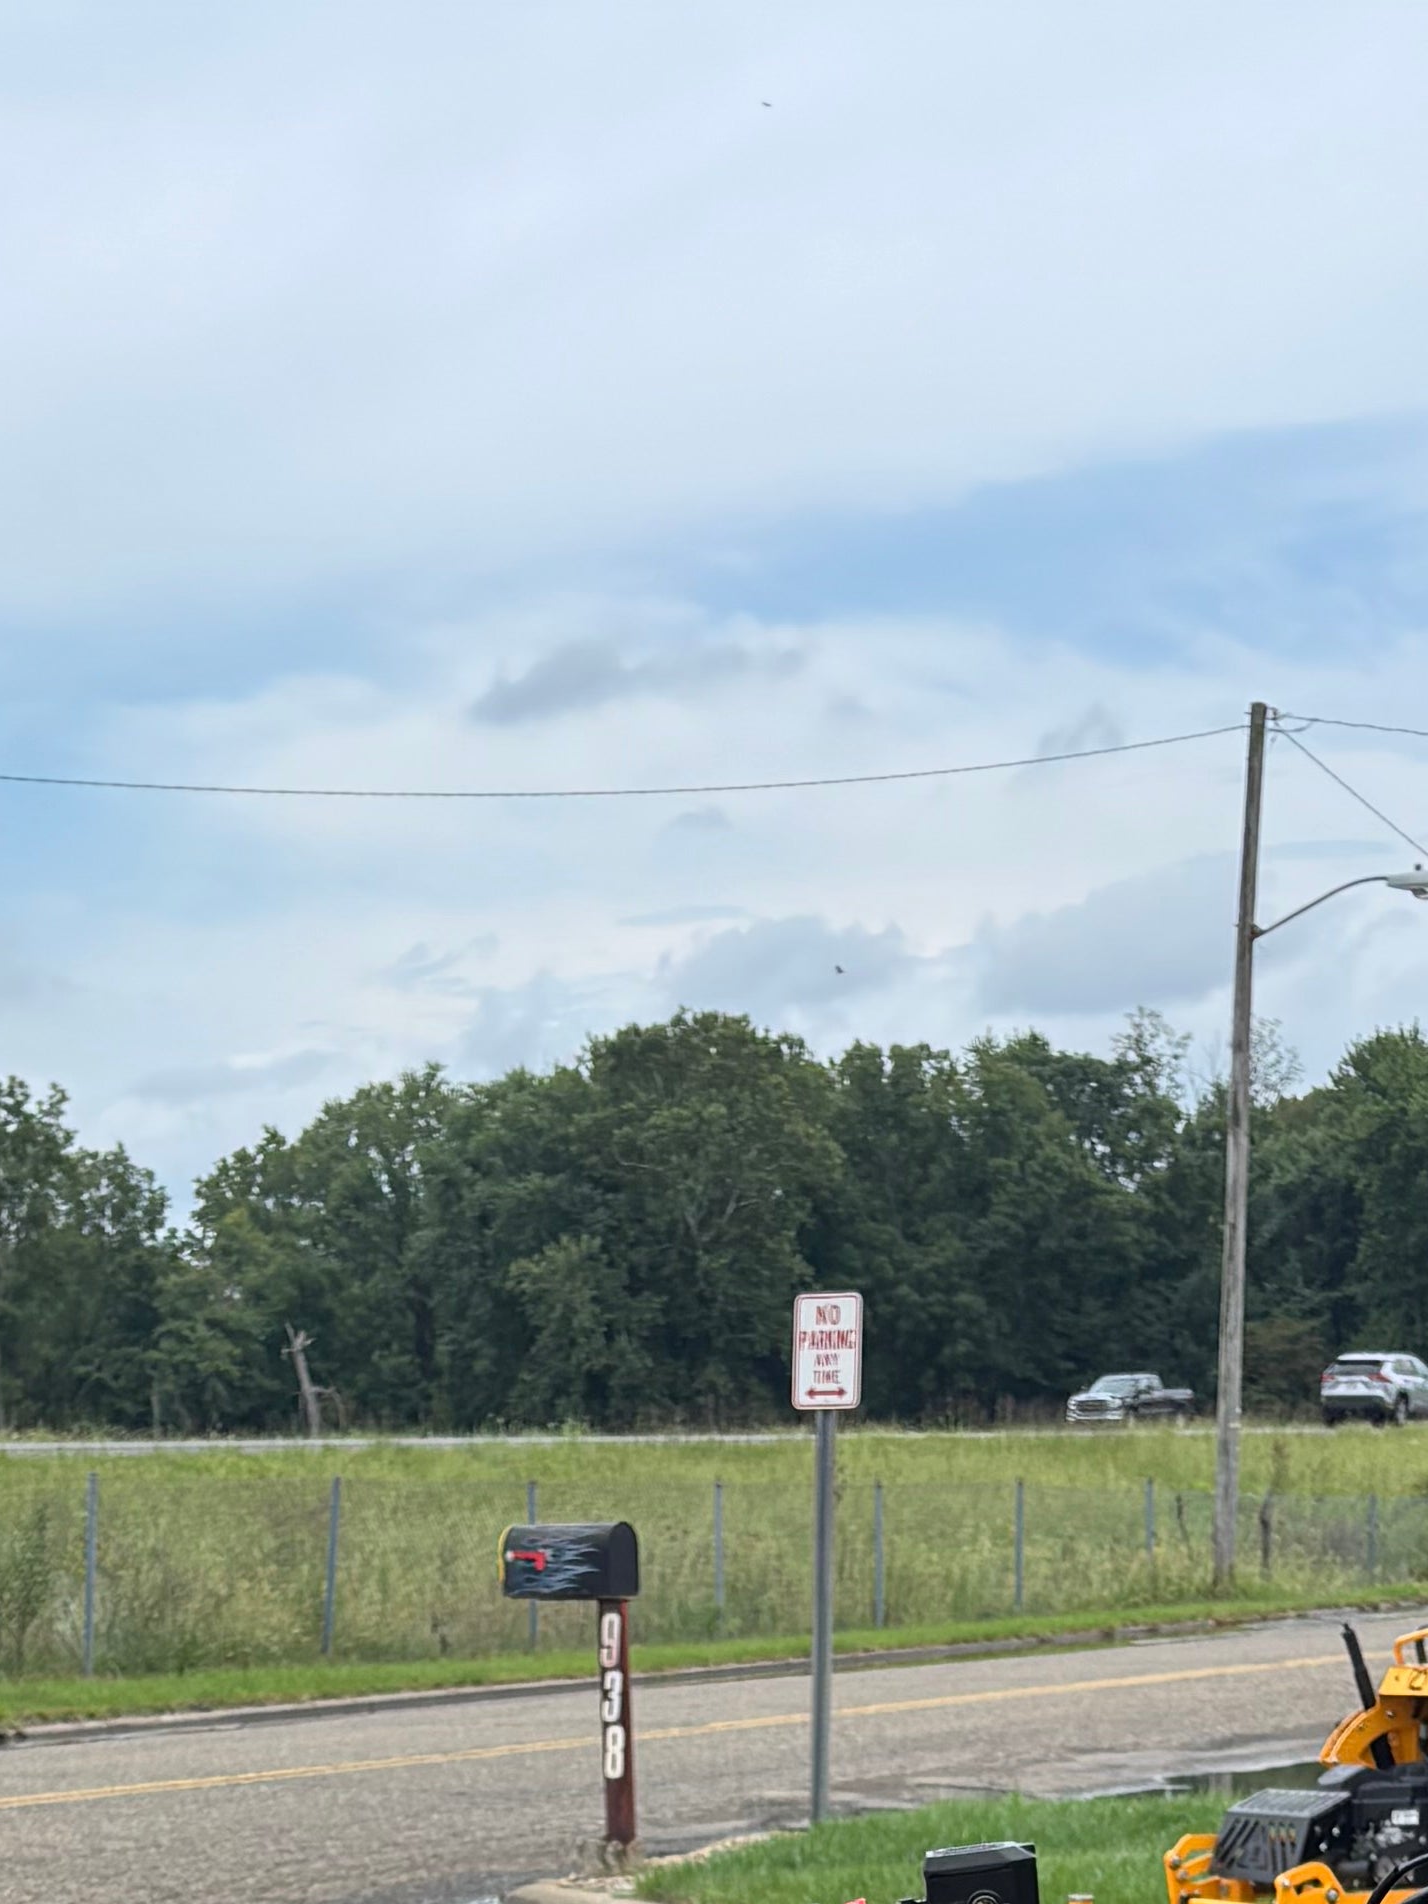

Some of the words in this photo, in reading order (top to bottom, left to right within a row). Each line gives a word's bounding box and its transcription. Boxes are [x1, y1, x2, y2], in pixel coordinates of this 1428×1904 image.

[816, 1304, 841, 1326] NO
[799, 1330, 856, 1350] PARKING
[814, 1353, 839, 1367] ANY
[813, 1370, 841, 1384] TIME
[599, 1612, 625, 1779] 938
